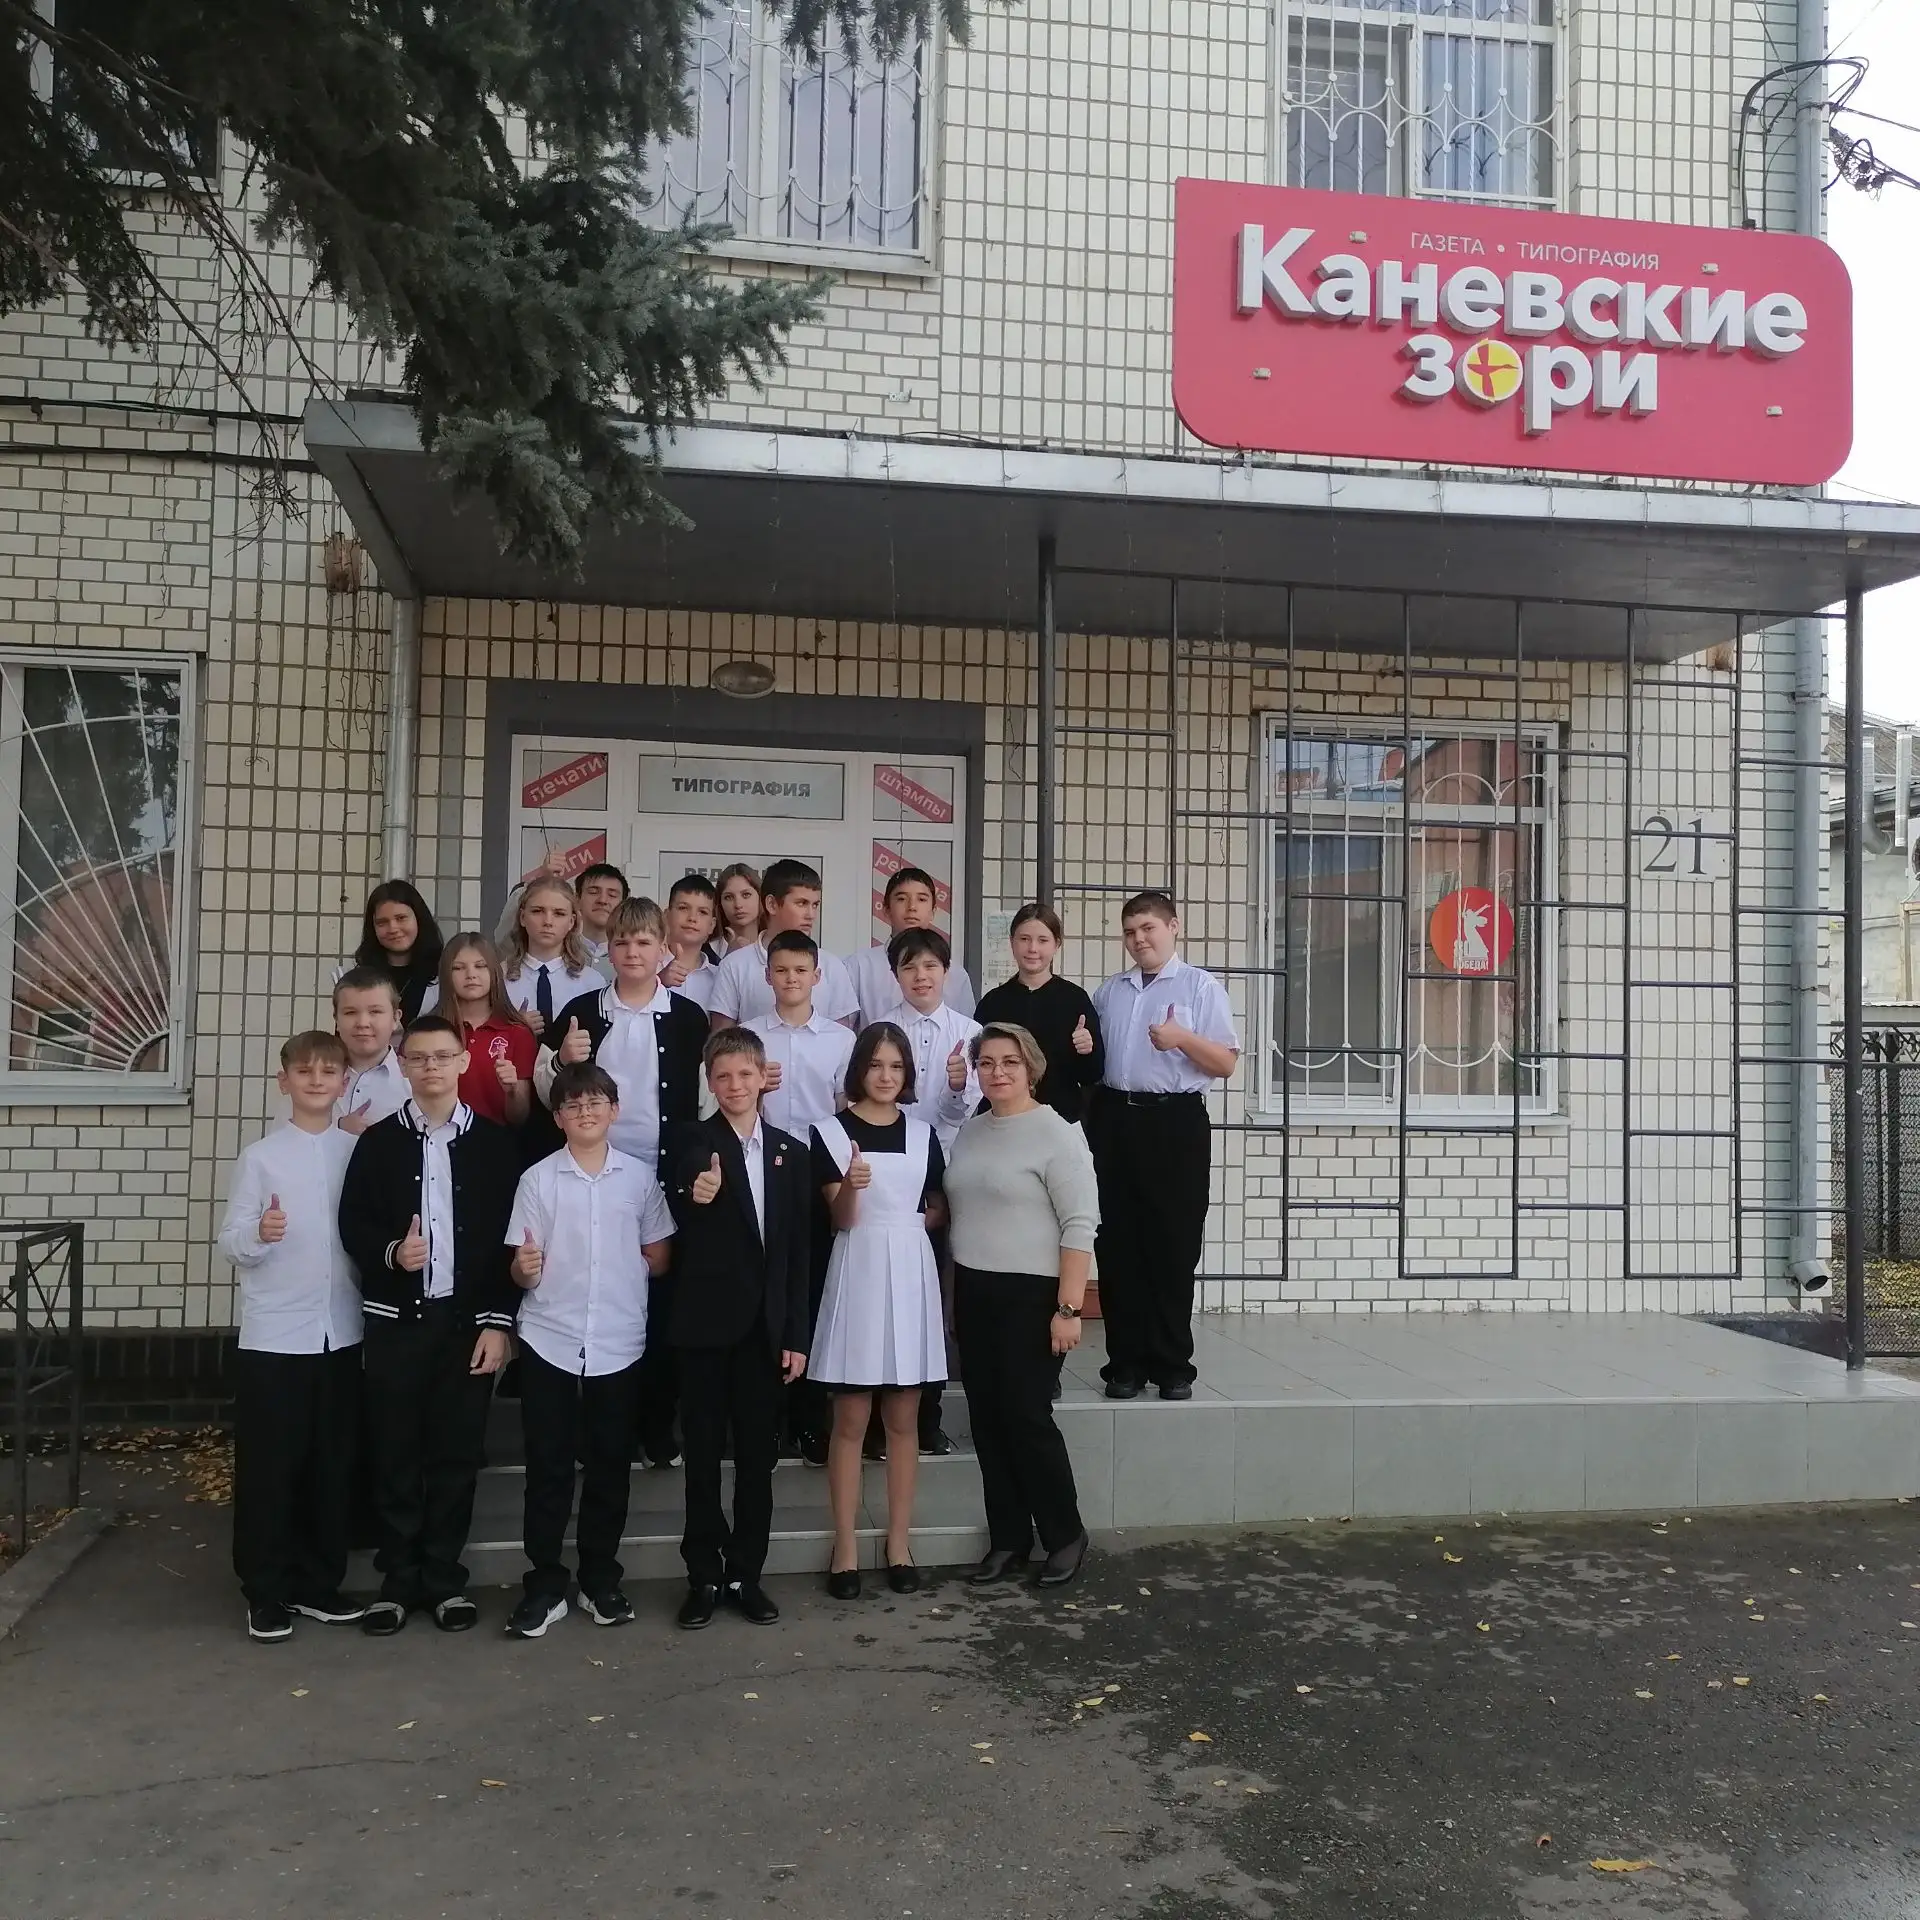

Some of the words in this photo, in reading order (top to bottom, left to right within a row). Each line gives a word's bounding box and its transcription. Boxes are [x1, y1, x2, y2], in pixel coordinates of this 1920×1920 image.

[1410, 231, 1486, 256] ГАЗЕТА
[1516, 241, 1660, 271] ТИПОГРАФИЯ
[1238, 223, 1808, 357] Каневские
[1402, 333, 1659, 435] зори
[529, 756, 604, 803] печати
[671, 777, 811, 798] ТИПОГРАФИЯ
[879, 771, 947, 819] штампы
[1643, 815, 1707, 875] 21
